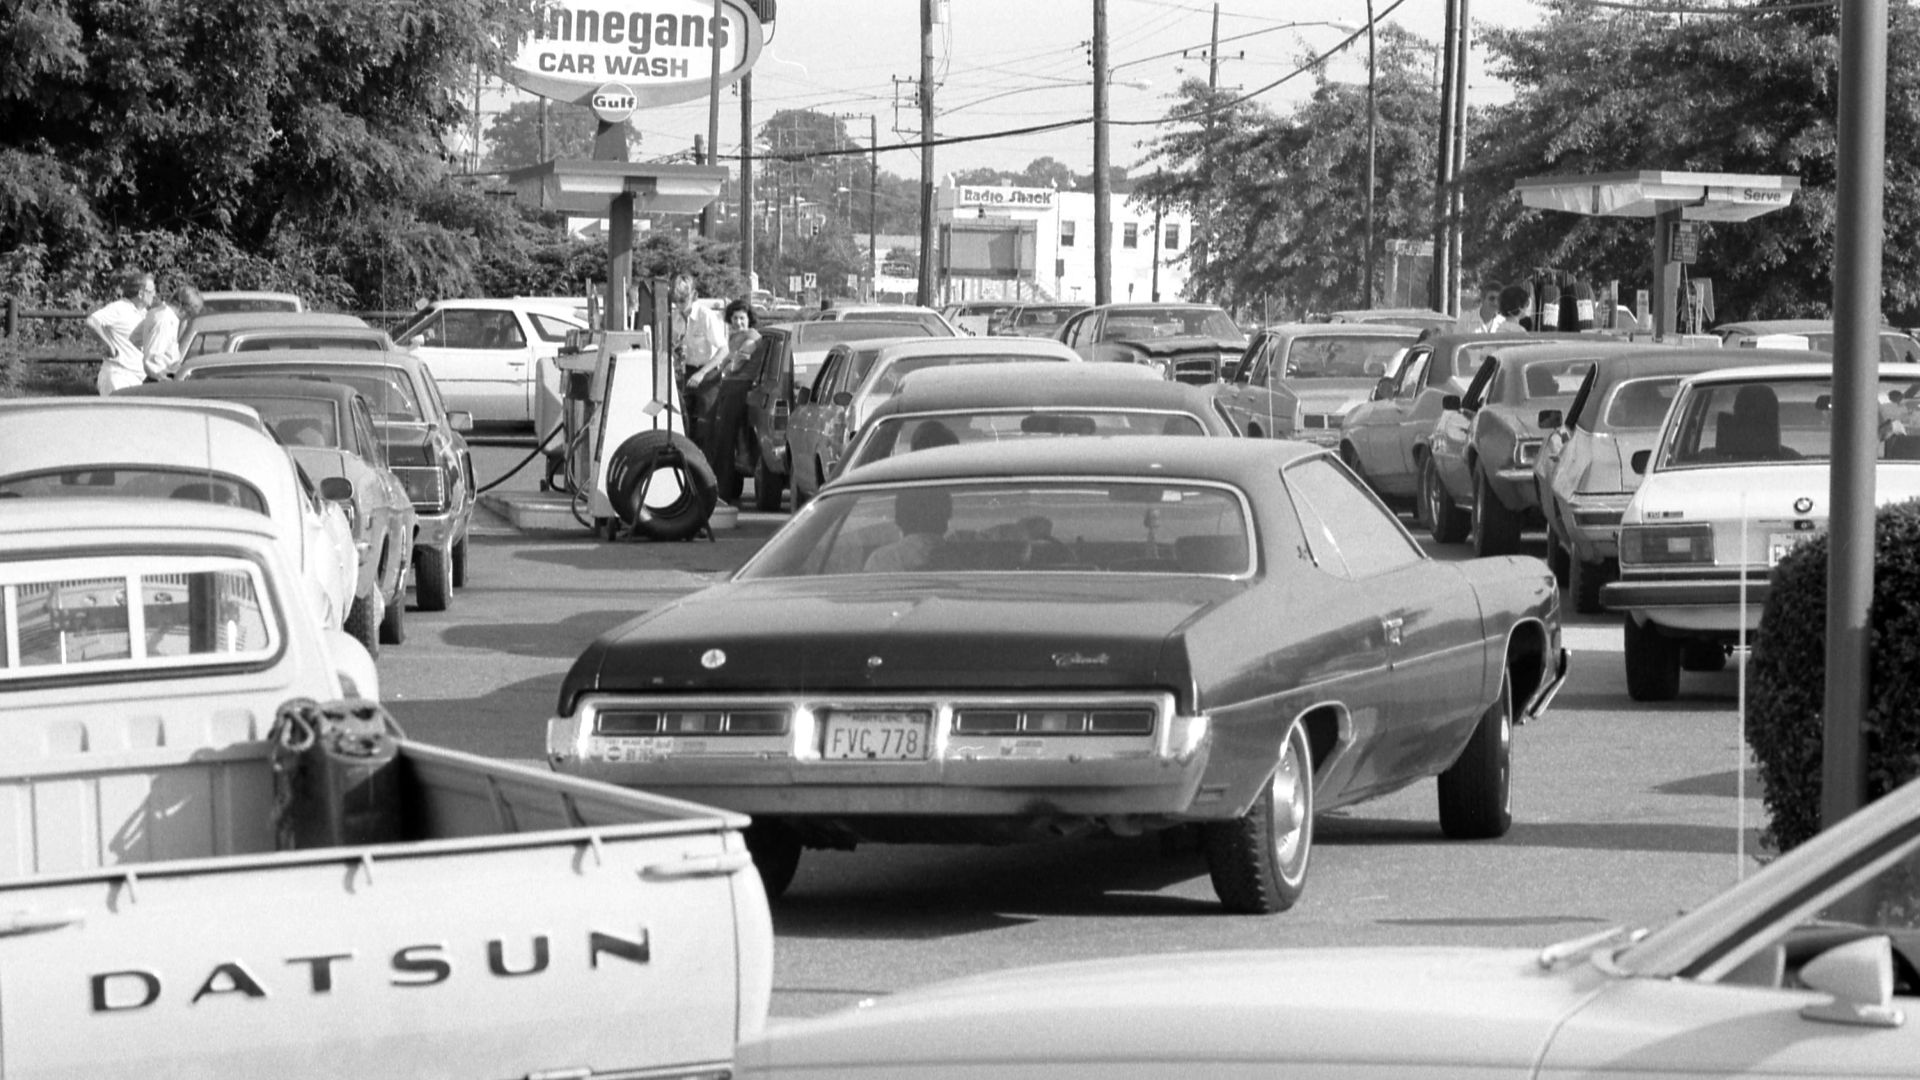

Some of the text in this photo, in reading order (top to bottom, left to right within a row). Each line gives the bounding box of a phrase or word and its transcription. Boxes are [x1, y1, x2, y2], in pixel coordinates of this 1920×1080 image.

[538, 51, 689, 78] CAR WASH
[593, 95, 635, 109] Gulf
[964, 188, 1052, 204] Radio Shack
[1743, 188, 1781, 202] Serve
[832, 728, 918, 754] FVC 778
[90, 926, 652, 1012] DATSUN
